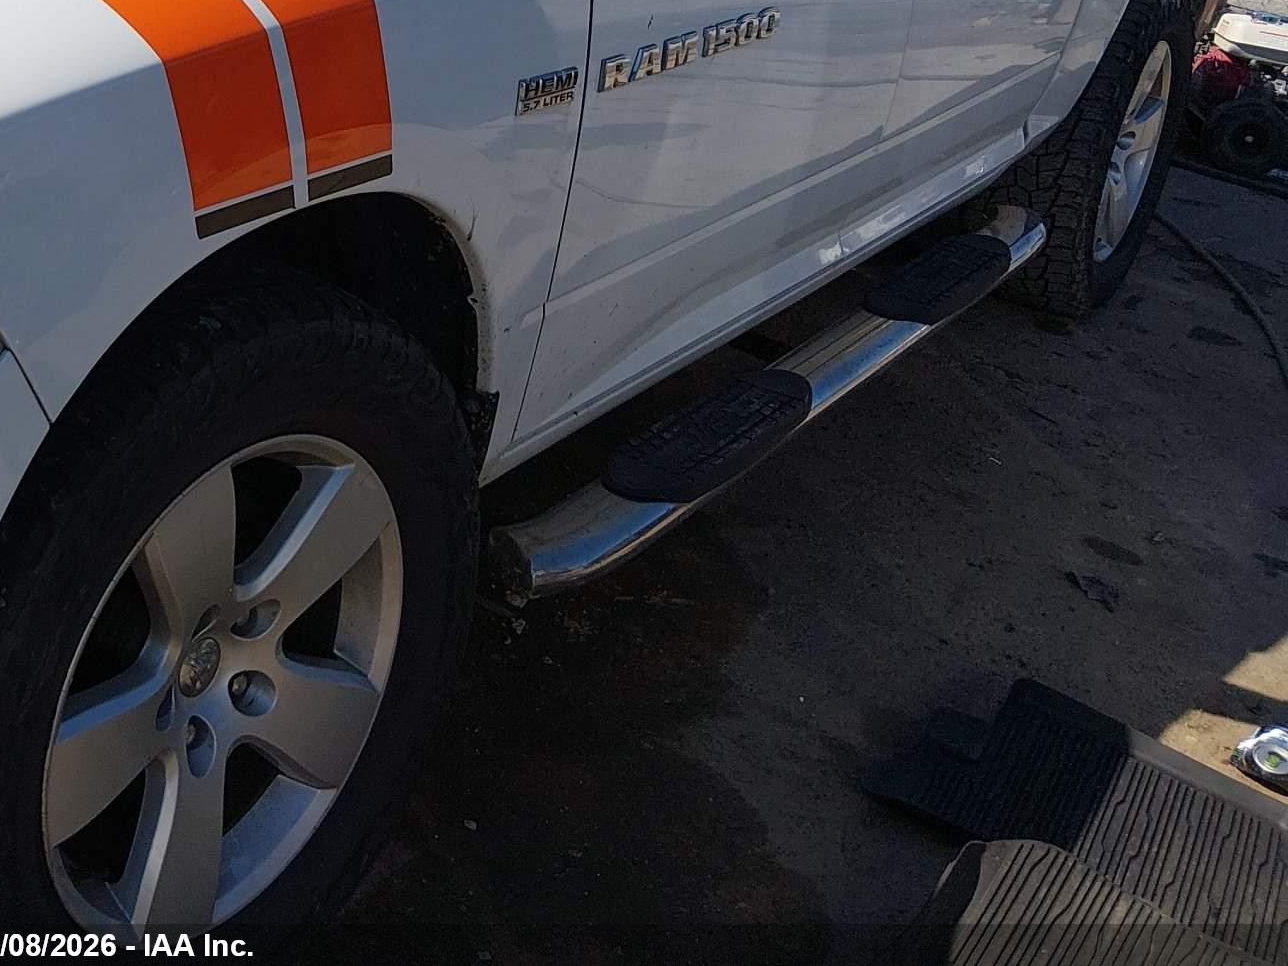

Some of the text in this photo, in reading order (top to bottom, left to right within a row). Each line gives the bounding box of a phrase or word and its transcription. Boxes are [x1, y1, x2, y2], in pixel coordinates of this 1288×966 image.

[597, 6, 782, 93] RAM 1500
[520, 67, 579, 101] HEMI
[522, 90, 574, 113] 5.7 LITER
